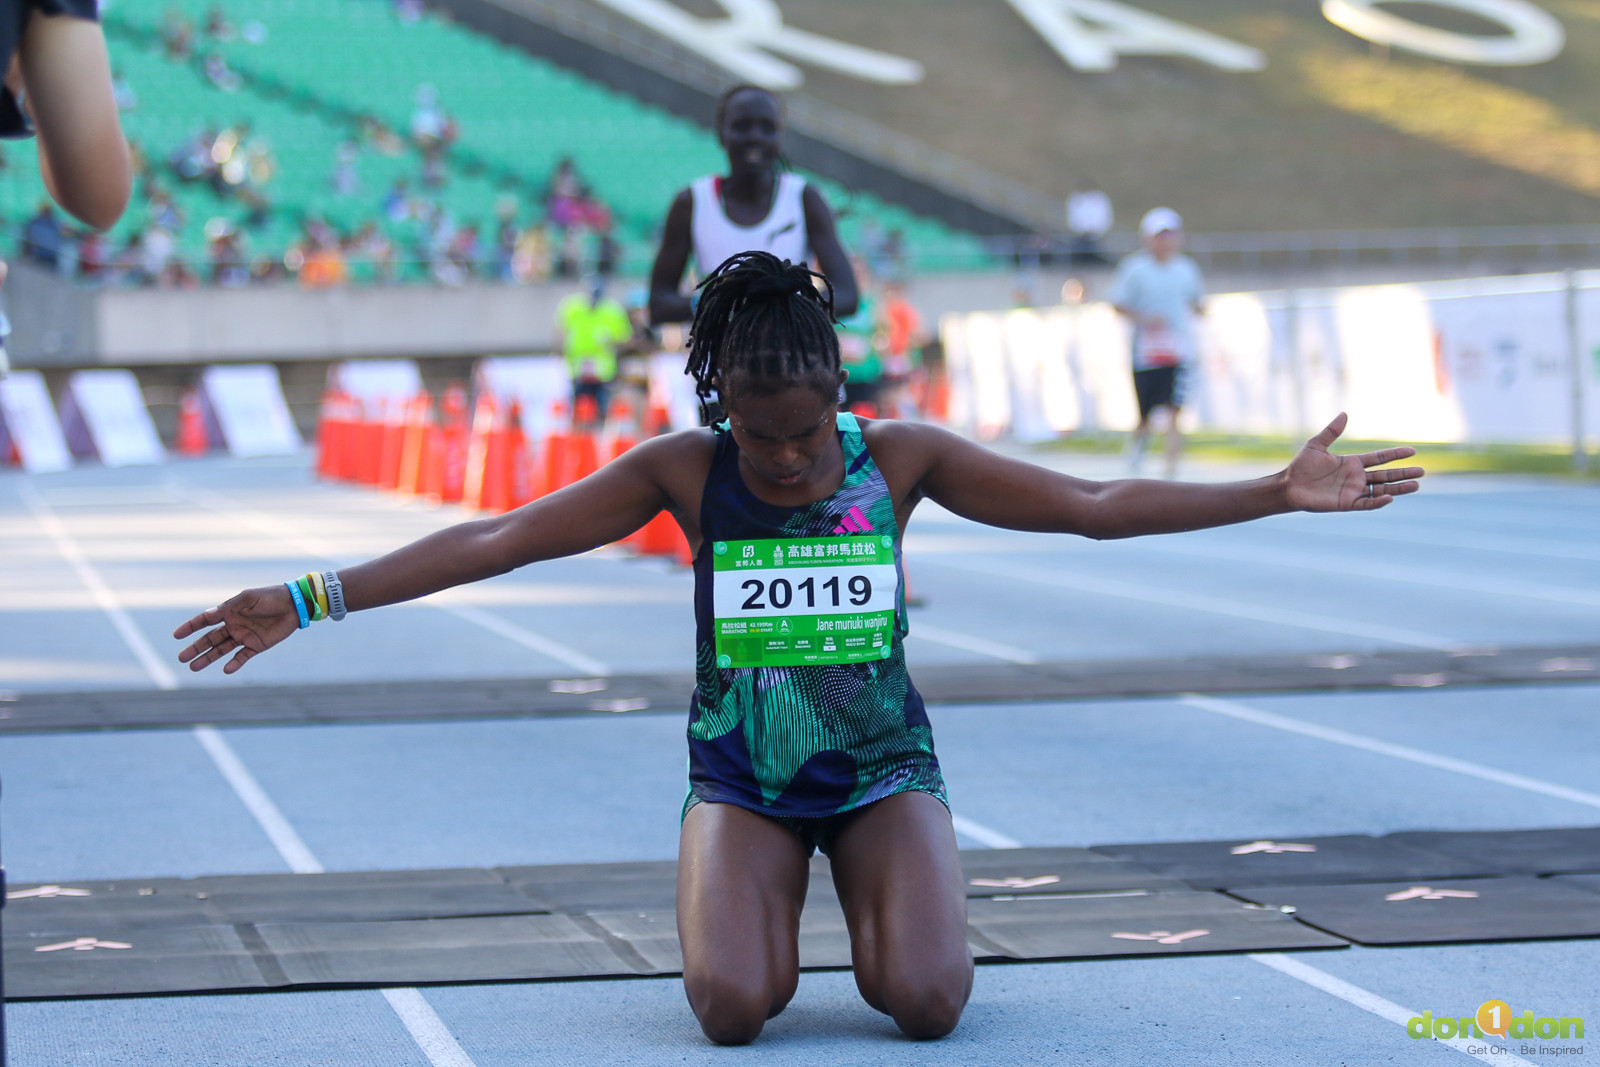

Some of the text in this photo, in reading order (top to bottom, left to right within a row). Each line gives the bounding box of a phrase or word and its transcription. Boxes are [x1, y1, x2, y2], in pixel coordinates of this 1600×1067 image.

[788, 543, 876, 558] 高雄富邦馬拉松
[741, 575, 872, 610] 20119
[781, 620, 788, 628] A
[816, 614, 888, 631] Jane muriuki wanjiru
